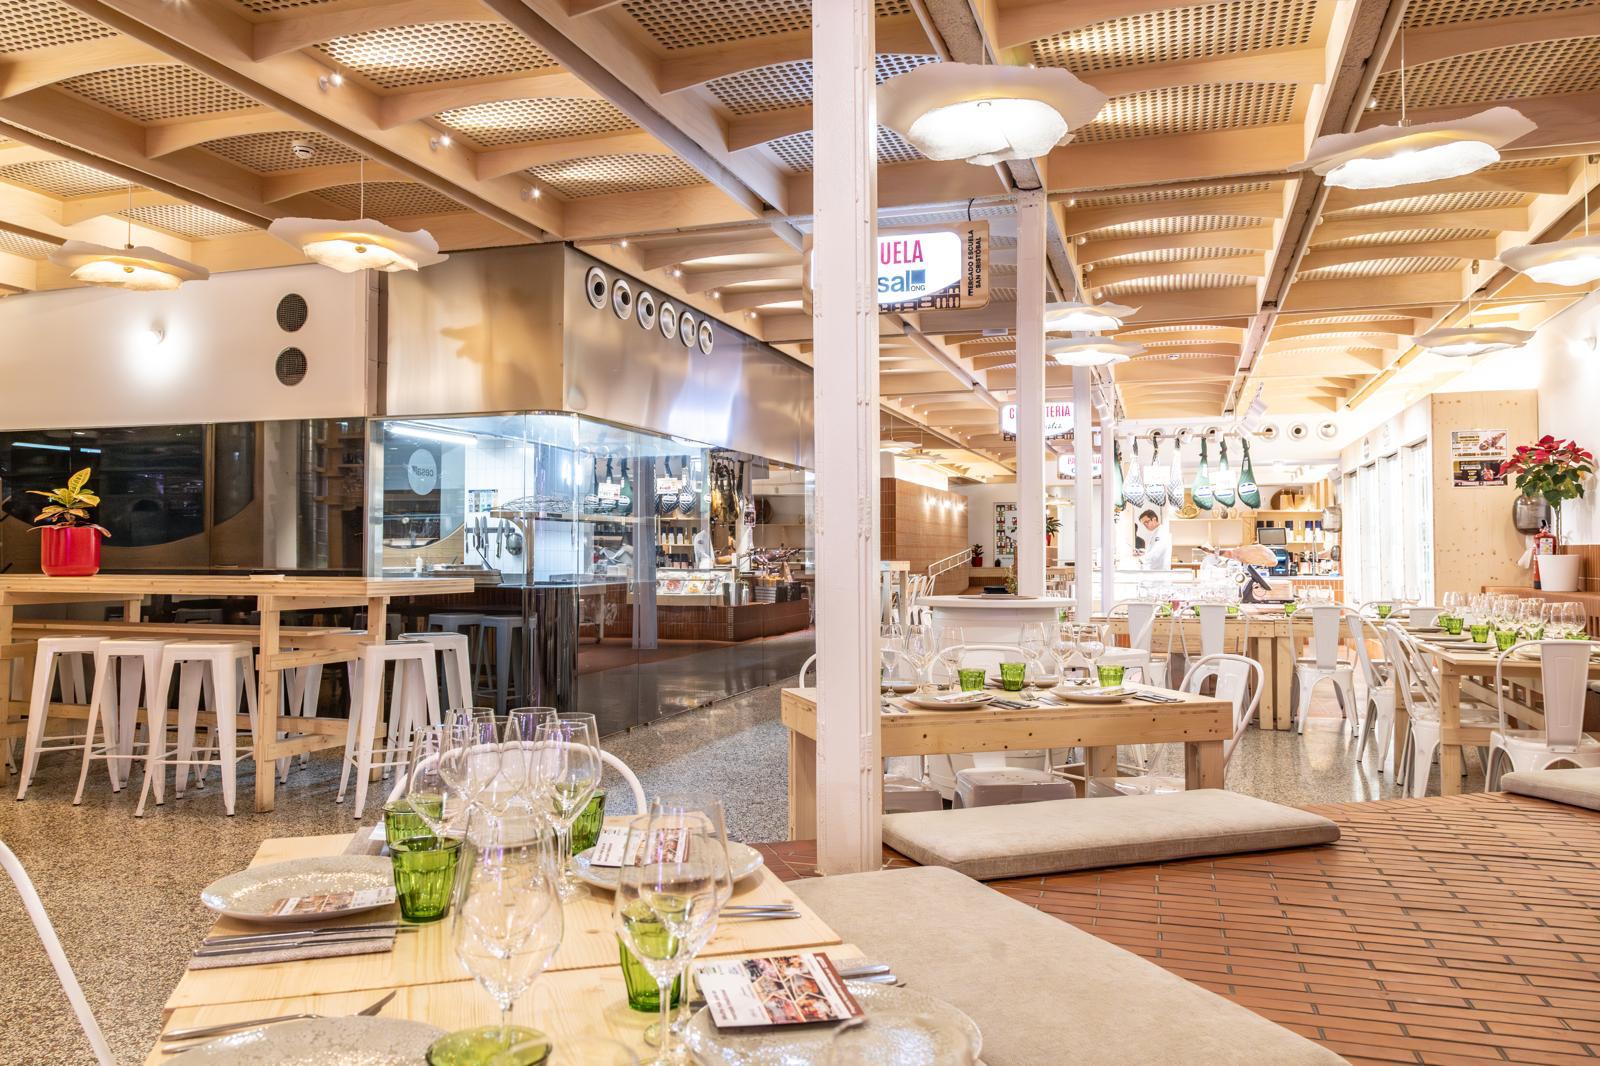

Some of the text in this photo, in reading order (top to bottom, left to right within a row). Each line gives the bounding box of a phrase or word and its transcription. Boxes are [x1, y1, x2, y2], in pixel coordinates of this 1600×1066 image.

[881, 240, 923, 264] UELA
[878, 270, 926, 293] sal ONG
[1009, 405, 1071, 419] CTERIA
